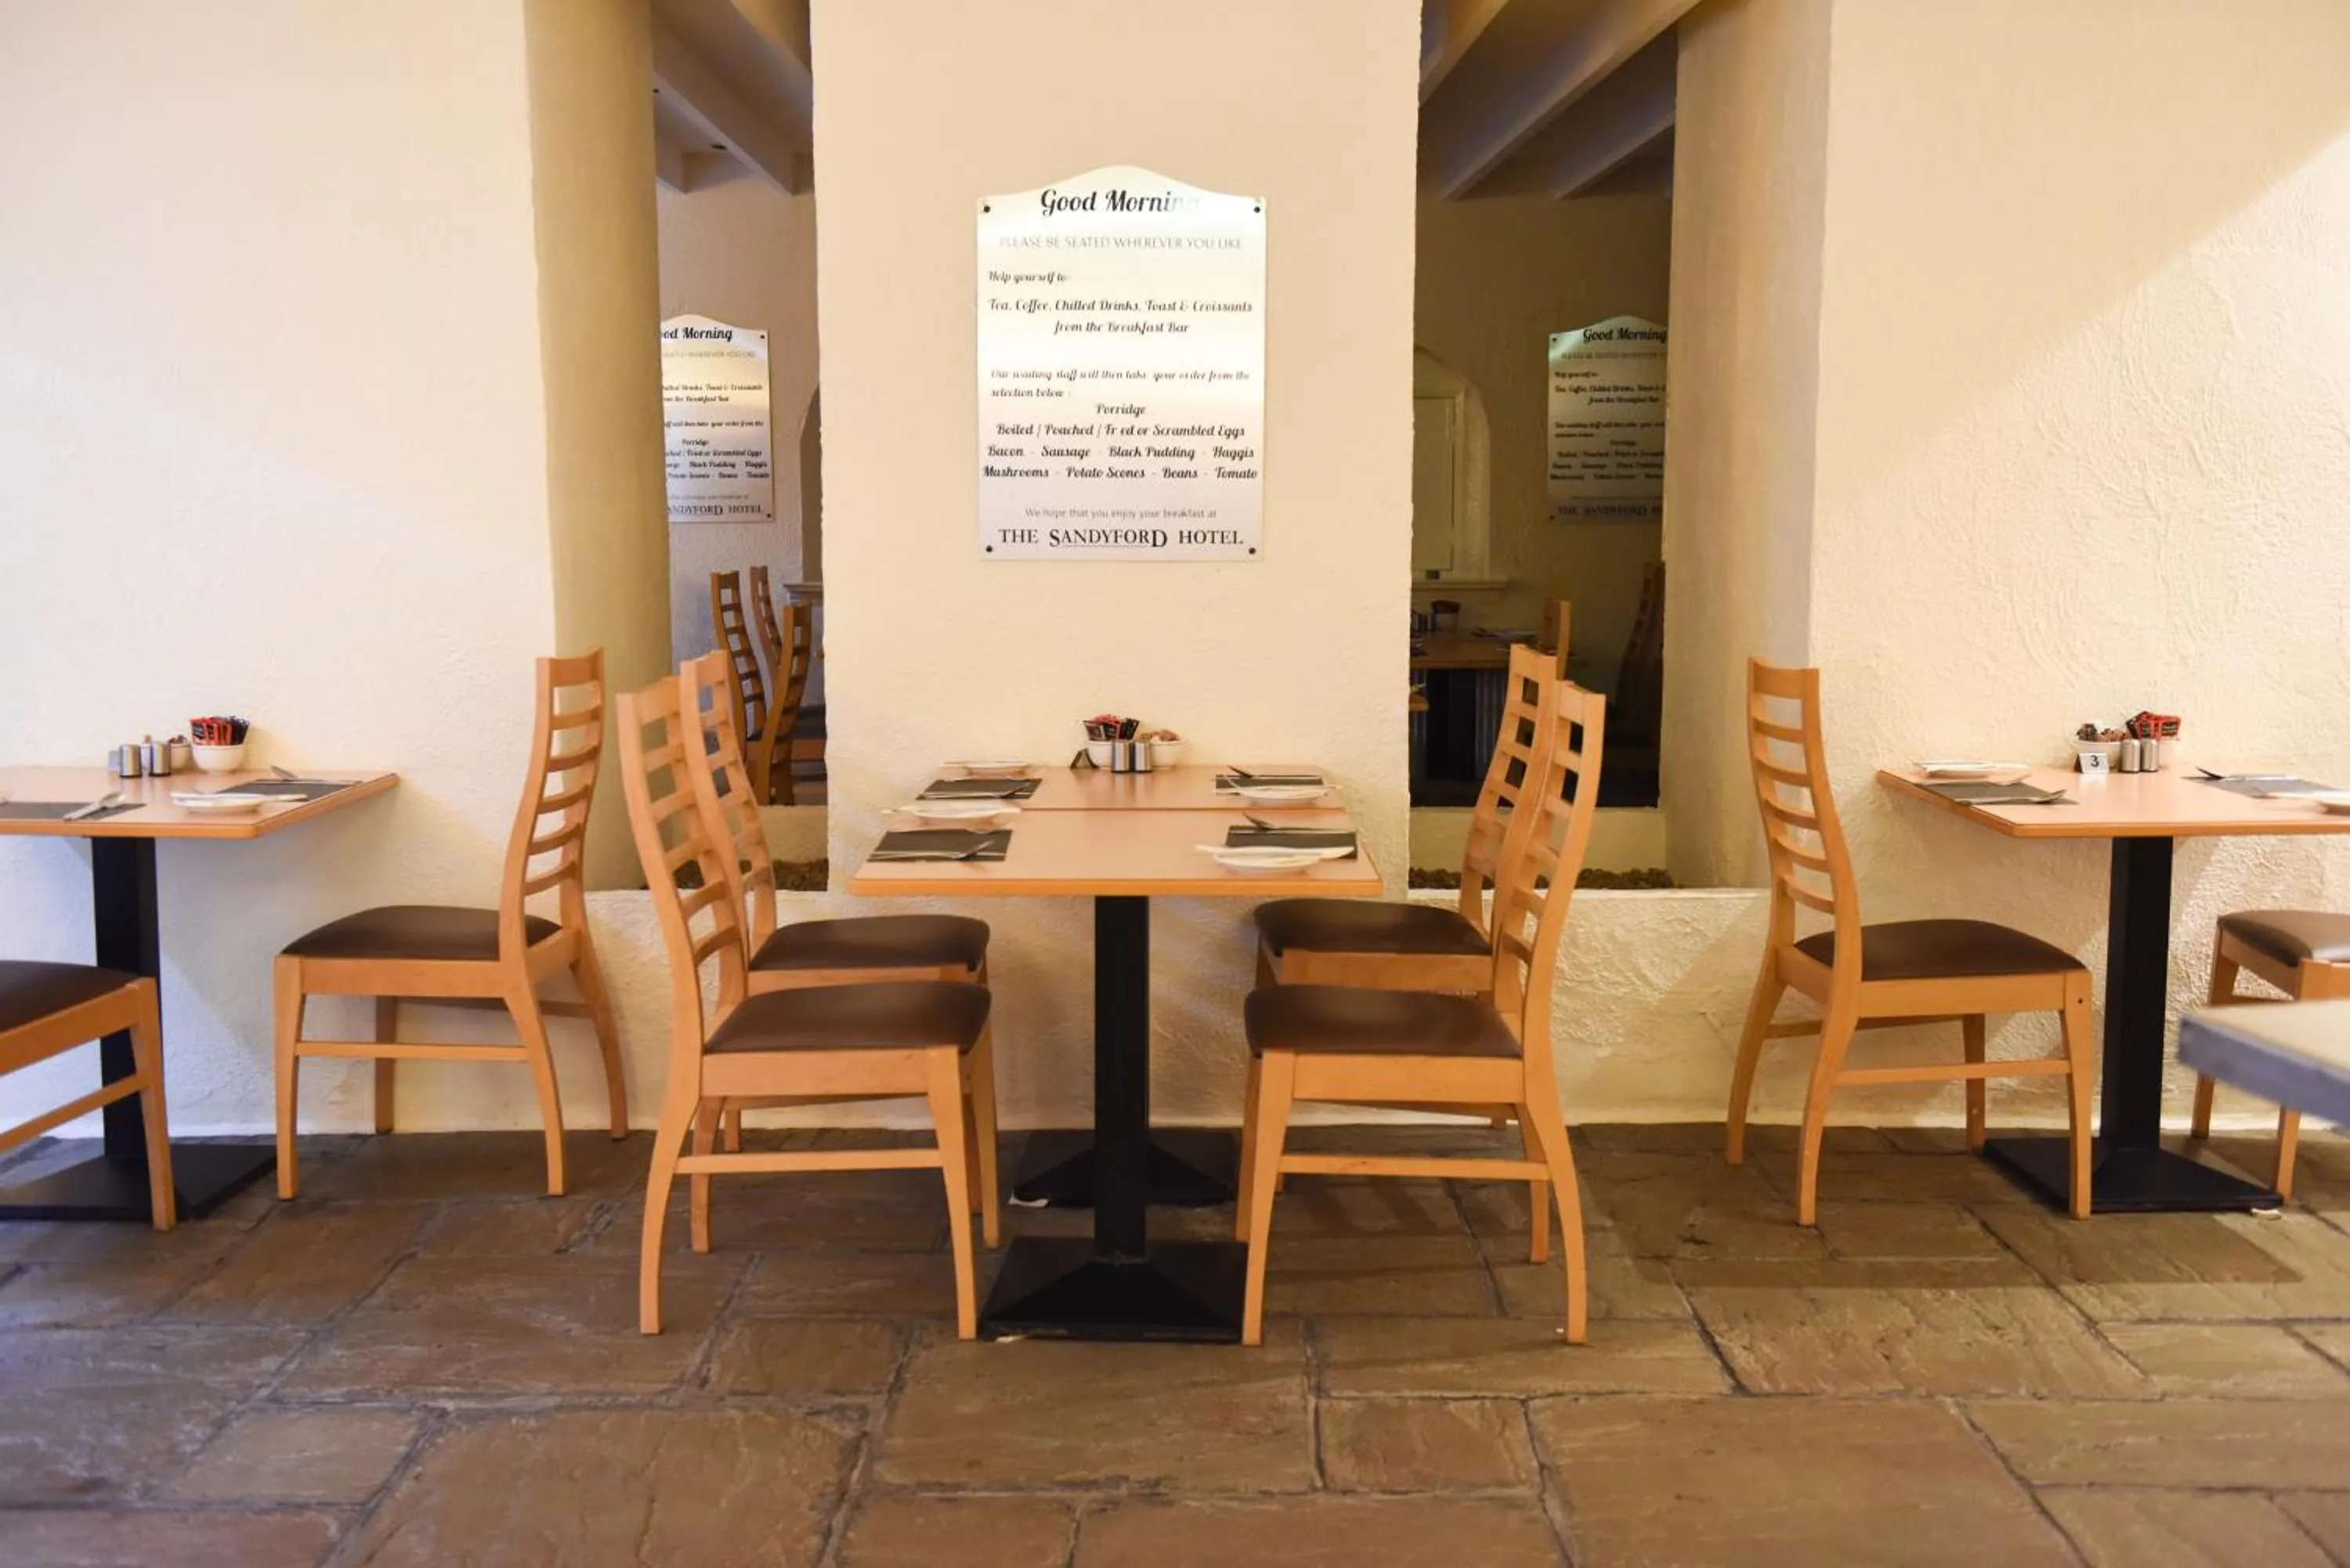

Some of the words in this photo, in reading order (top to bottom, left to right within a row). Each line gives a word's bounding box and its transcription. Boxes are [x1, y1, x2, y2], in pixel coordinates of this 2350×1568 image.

[1040, 190, 1097, 217] Good
[1000, 237, 1042, 248] PLEASE
[1046, 237, 1059, 248] BE
[1066, 237, 1111, 248] SEATED
[1114, 237, 1183, 248] WHEREVER
[1186, 237, 1214, 248] YOU
[1217, 237, 1242, 248] LIKE
[989, 271, 1011, 284] Help
[1055, 298, 1096, 311] Chilled
[1144, 298, 1177, 311] Toast
[1192, 298, 1253, 311] Croissants
[682, 327, 733, 342] Morning
[1054, 322, 1083, 335] from
[1086, 322, 1103, 333] the
[1107, 322, 1164, 335] Breakfast
[1167, 322, 1191, 333] Bar
[1583, 327, 1614, 343] Good
[1617, 327, 1667, 343] Morning
[1056, 370, 1078, 382] staff
[1101, 370, 1123, 379] then
[1152, 370, 1176, 381] your
[1235, 370, 1250, 379] the
[1095, 403, 1146, 417] Porridge
[996, 424, 1034, 435] Boiled
[1044, 424, 1094, 435] Poached
[1104, 424, 1134, 435] Fred
[1137, 424, 1151, 435] or
[1152, 424, 1215, 435] Scrambled
[1217, 424, 1246, 438] Eggs
[988, 446, 1025, 457] Bacon
[1040, 446, 1091, 460] Sausage
[1108, 446, 1142, 457] Black
[1144, 446, 1196, 461] Pudding
[1211, 446, 1255, 461] Haggis
[983, 466, 1049, 478] Mushrooms
[1066, 466, 1103, 478] Potato
[1105, 466, 1145, 478] Scones
[1162, 466, 1198, 478] Beans
[1214, 466, 1257, 478] Tomato
[728, 505, 764, 515] HOTEL
[1025, 509, 1040, 518] We
[1043, 509, 1065, 520] hope
[1069, 509, 1088, 518] that
[1091, 509, 1108, 520] you
[1111, 509, 1136, 520] enjoy
[1139, 509, 1159, 520] your
[1162, 509, 1204, 518] breakfast
[1208, 509, 1217, 518] at
[1000, 529, 1039, 544] THE
[1049, 529, 1168, 547] SANDYFORD
[1178, 529, 1244, 544] HOTEL
[2090, 754, 2100, 768] 3
